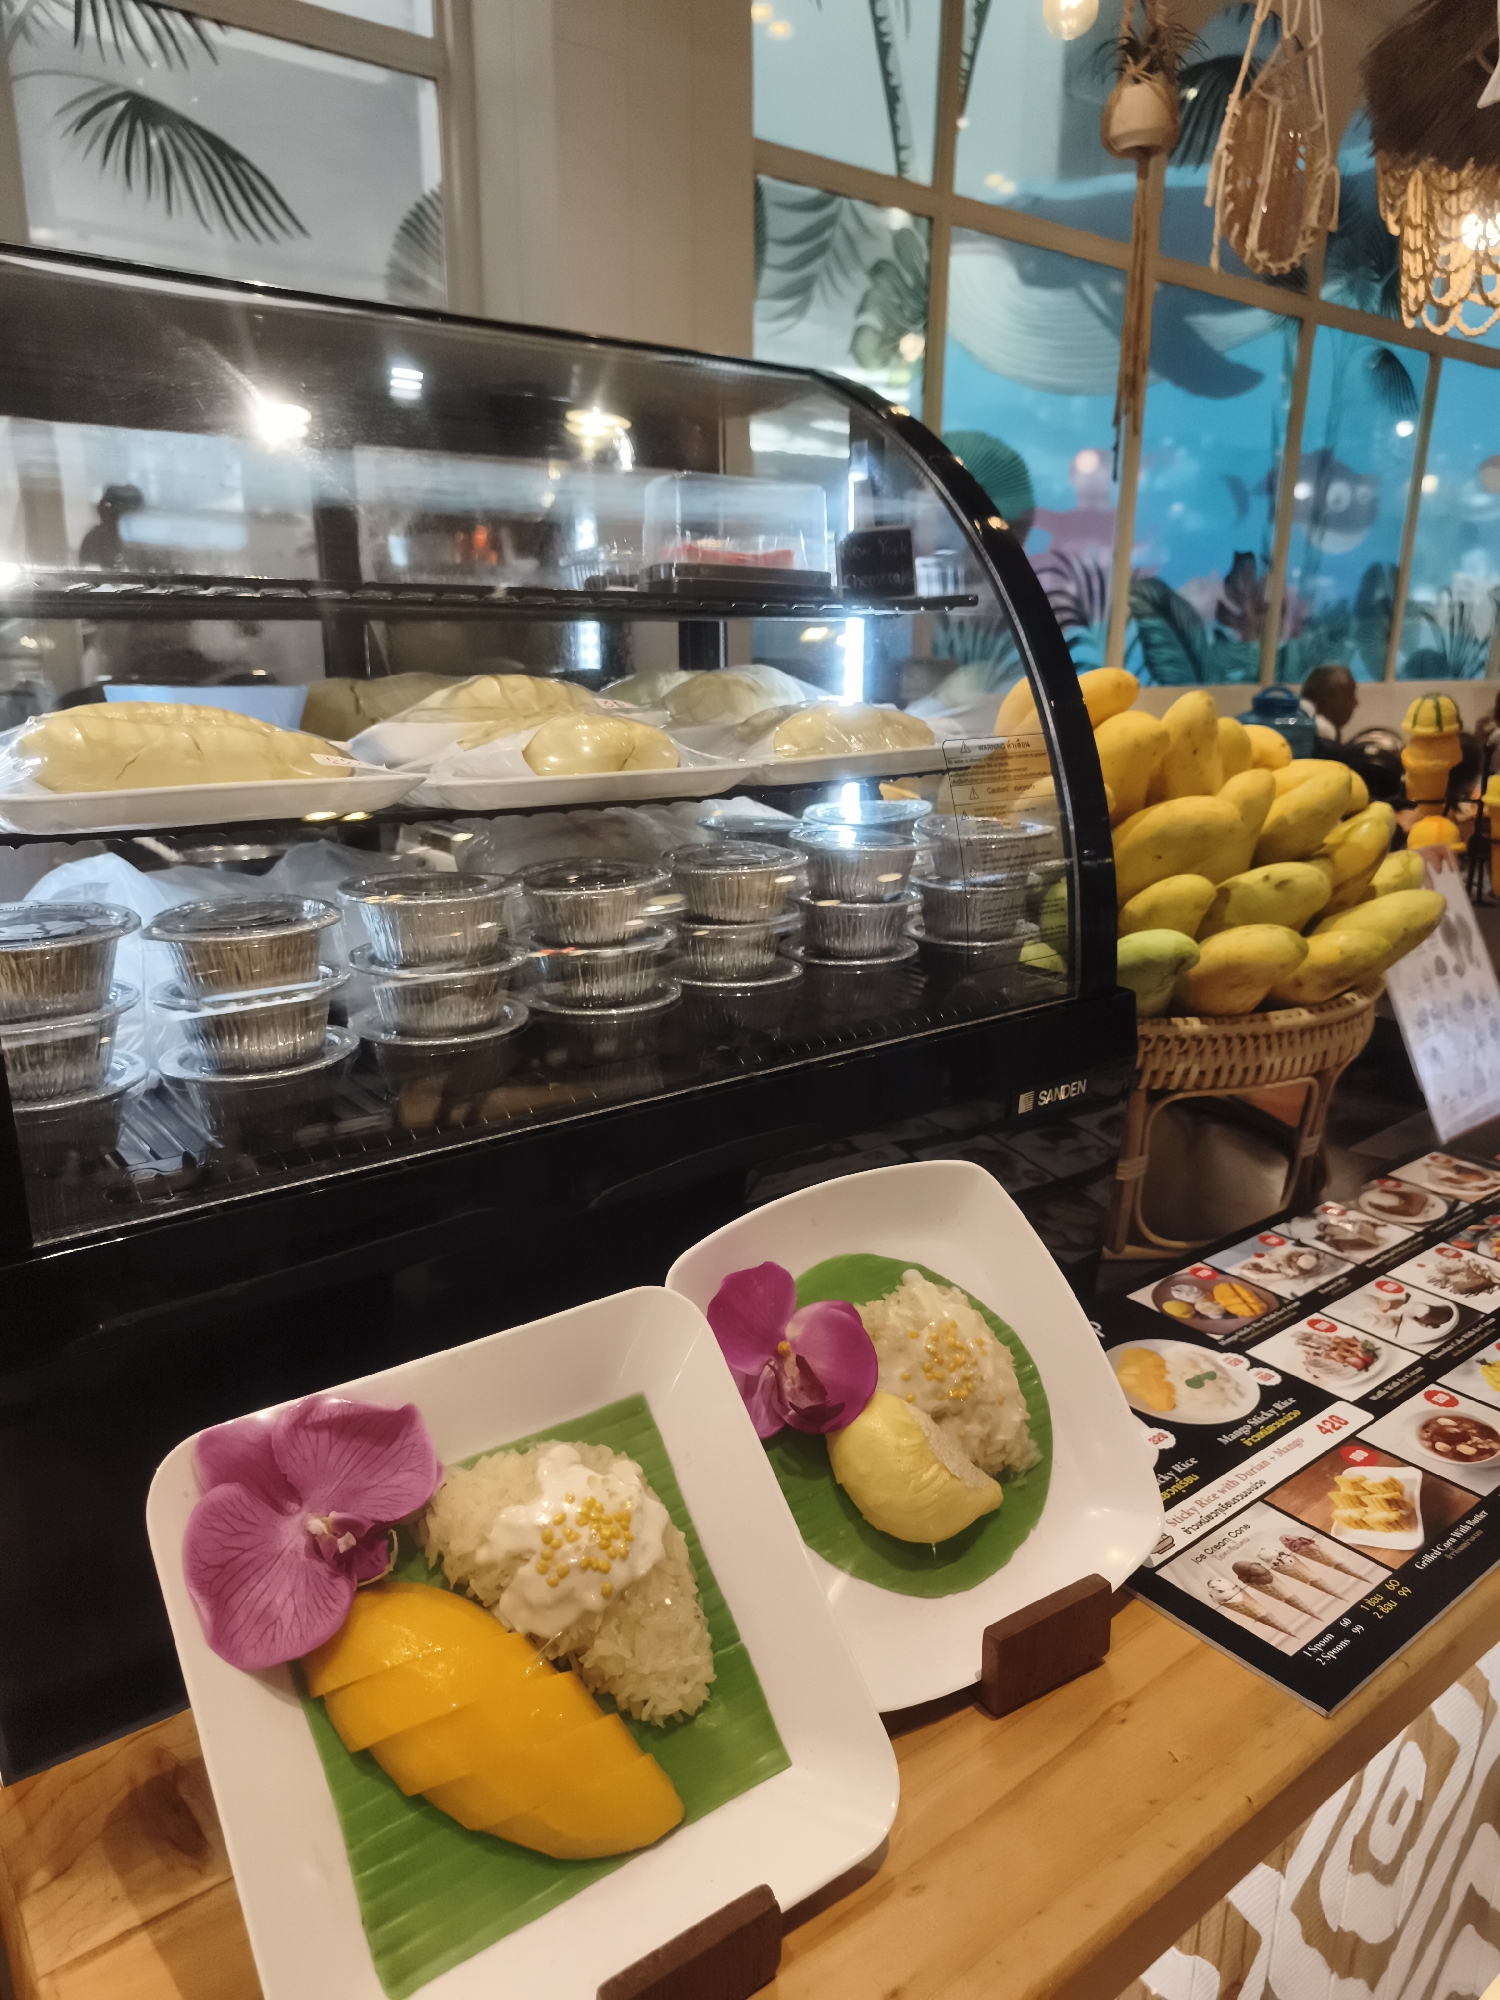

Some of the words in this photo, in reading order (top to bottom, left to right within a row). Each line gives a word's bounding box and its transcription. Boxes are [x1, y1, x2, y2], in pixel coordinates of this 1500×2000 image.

[978, 743, 1005, 751] WARNING
[1038, 1079, 1086, 1106] SANDEN
[1217, 1424, 1251, 1445] Mango
[1246, 1408, 1279, 1426] Sticky
[1272, 1397, 1297, 1410] Rice
[1316, 1414, 1349, 1435] 420
[1156, 1470, 1180, 1486] cky
[1171, 1457, 1198, 1473] Rice
[1165, 1505, 1201, 1527] Sticky
[1194, 1491, 1220, 1509] Rice
[1217, 1478, 1241, 1495] with
[1234, 1459, 1271, 1482] Durian
[1272, 1437, 1305, 1458] Mango
[1191, 1553, 1207, 1565] Ice
[1204, 1537, 1232, 1555] Cream
[1228, 1523, 1251, 1538] Cone
[1414, 1548, 1442, 1570] Grilled
[1436, 1537, 1457, 1551] Corn
[1450, 1524, 1472, 1538] With
[1465, 1509, 1489, 1527] Butter
[1384, 1579, 1400, 1591] 60
[1373, 1611, 1384, 1619] 2
[1397, 1586, 1412, 1597] 99
[1339, 1617, 1352, 1628] 60
[1303, 1649, 1312, 1657] 1
[1307, 1633, 1335, 1654] Spoon
[1315, 1657, 1326, 1666] 2
[1321, 1637, 1351, 1661] Spoons
[1351, 1624, 1365, 1635] 99
